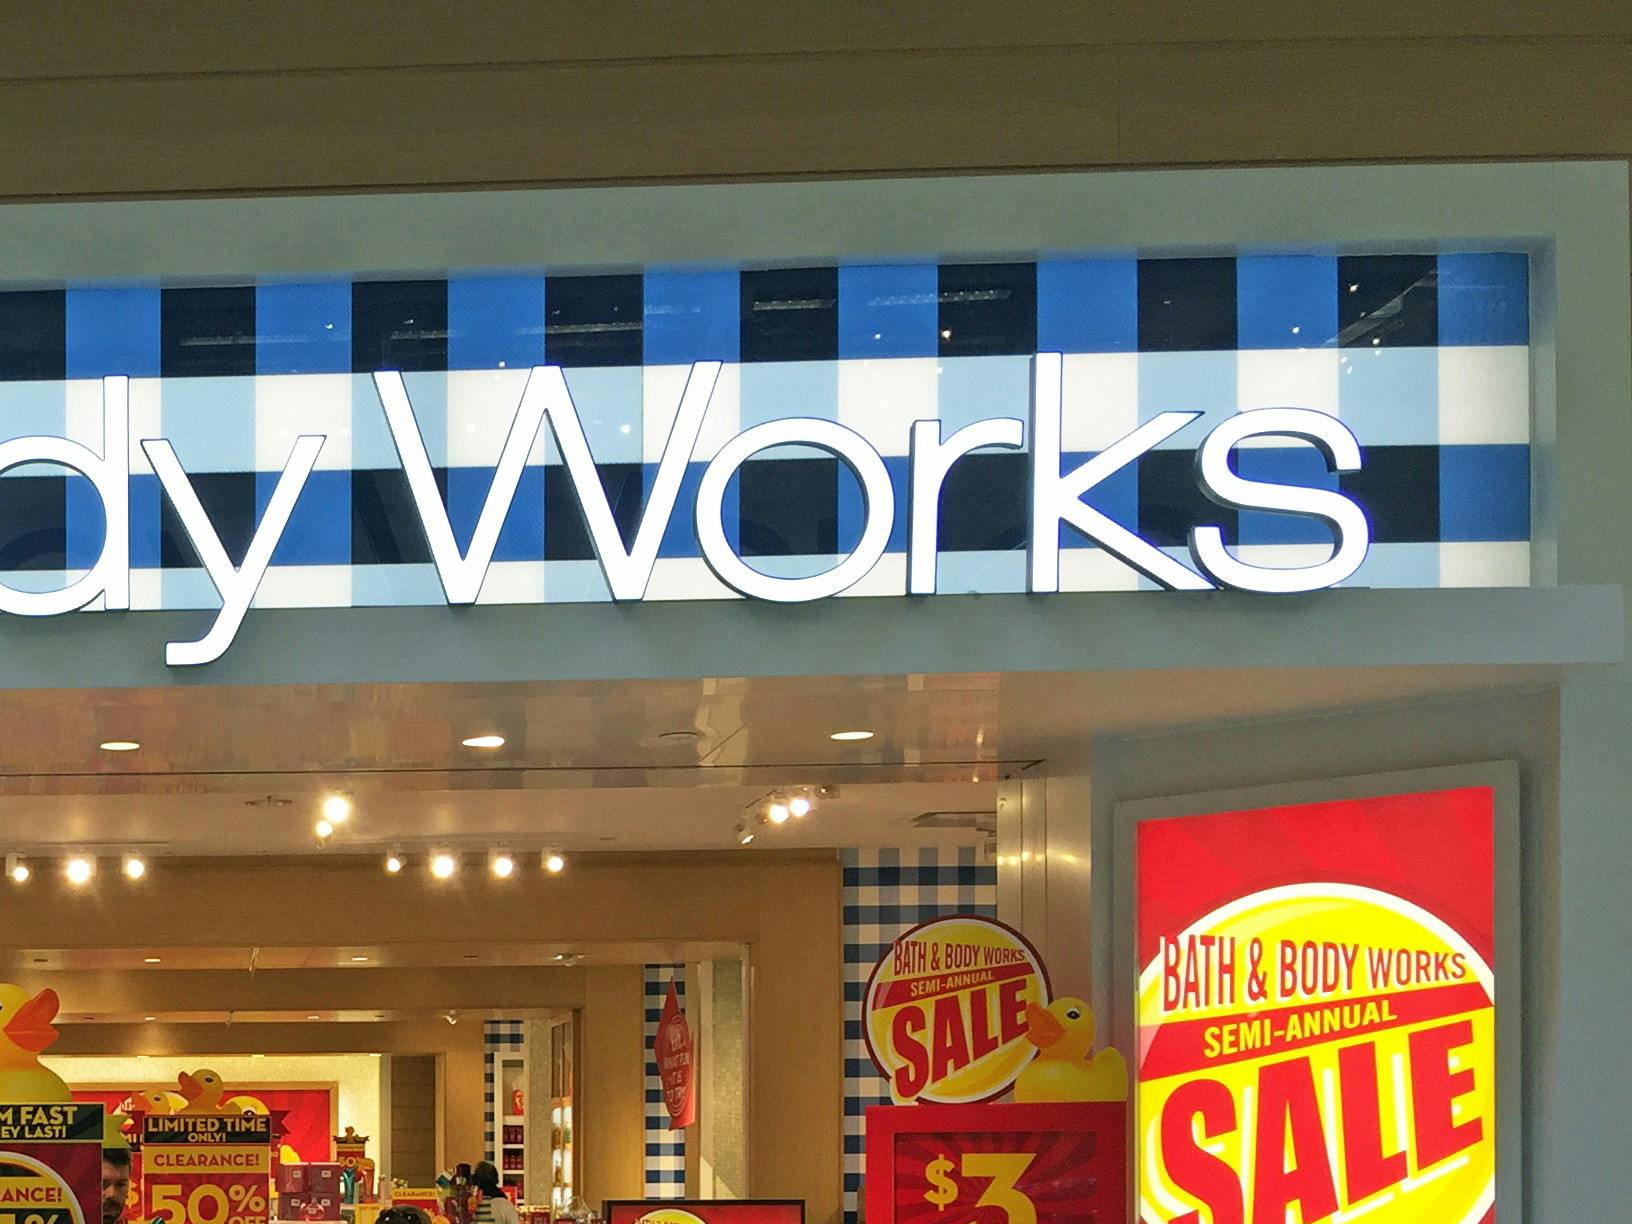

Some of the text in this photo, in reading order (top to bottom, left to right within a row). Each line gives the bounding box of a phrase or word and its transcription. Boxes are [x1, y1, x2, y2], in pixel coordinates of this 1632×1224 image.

[372, 351, 1370, 604] Works
[894, 940, 1025, 976] BATH & BODY WORKS
[910, 969, 995, 997] SEMI-ANNUAL
[1163, 934, 1467, 1012] BATH & BODY WORKS
[892, 979, 1029, 1098] SALE
[1204, 1000, 1397, 1058] SEMI-ANNUAL
[20, 1106, 78, 1125] FAST
[148, 1118, 266, 1132] LIMITED TIME
[24, 1125, 67, 1139] LAST!
[188, 1132, 226, 1142] ONLY!
[154, 1154, 259, 1167] CLEARANCE!
